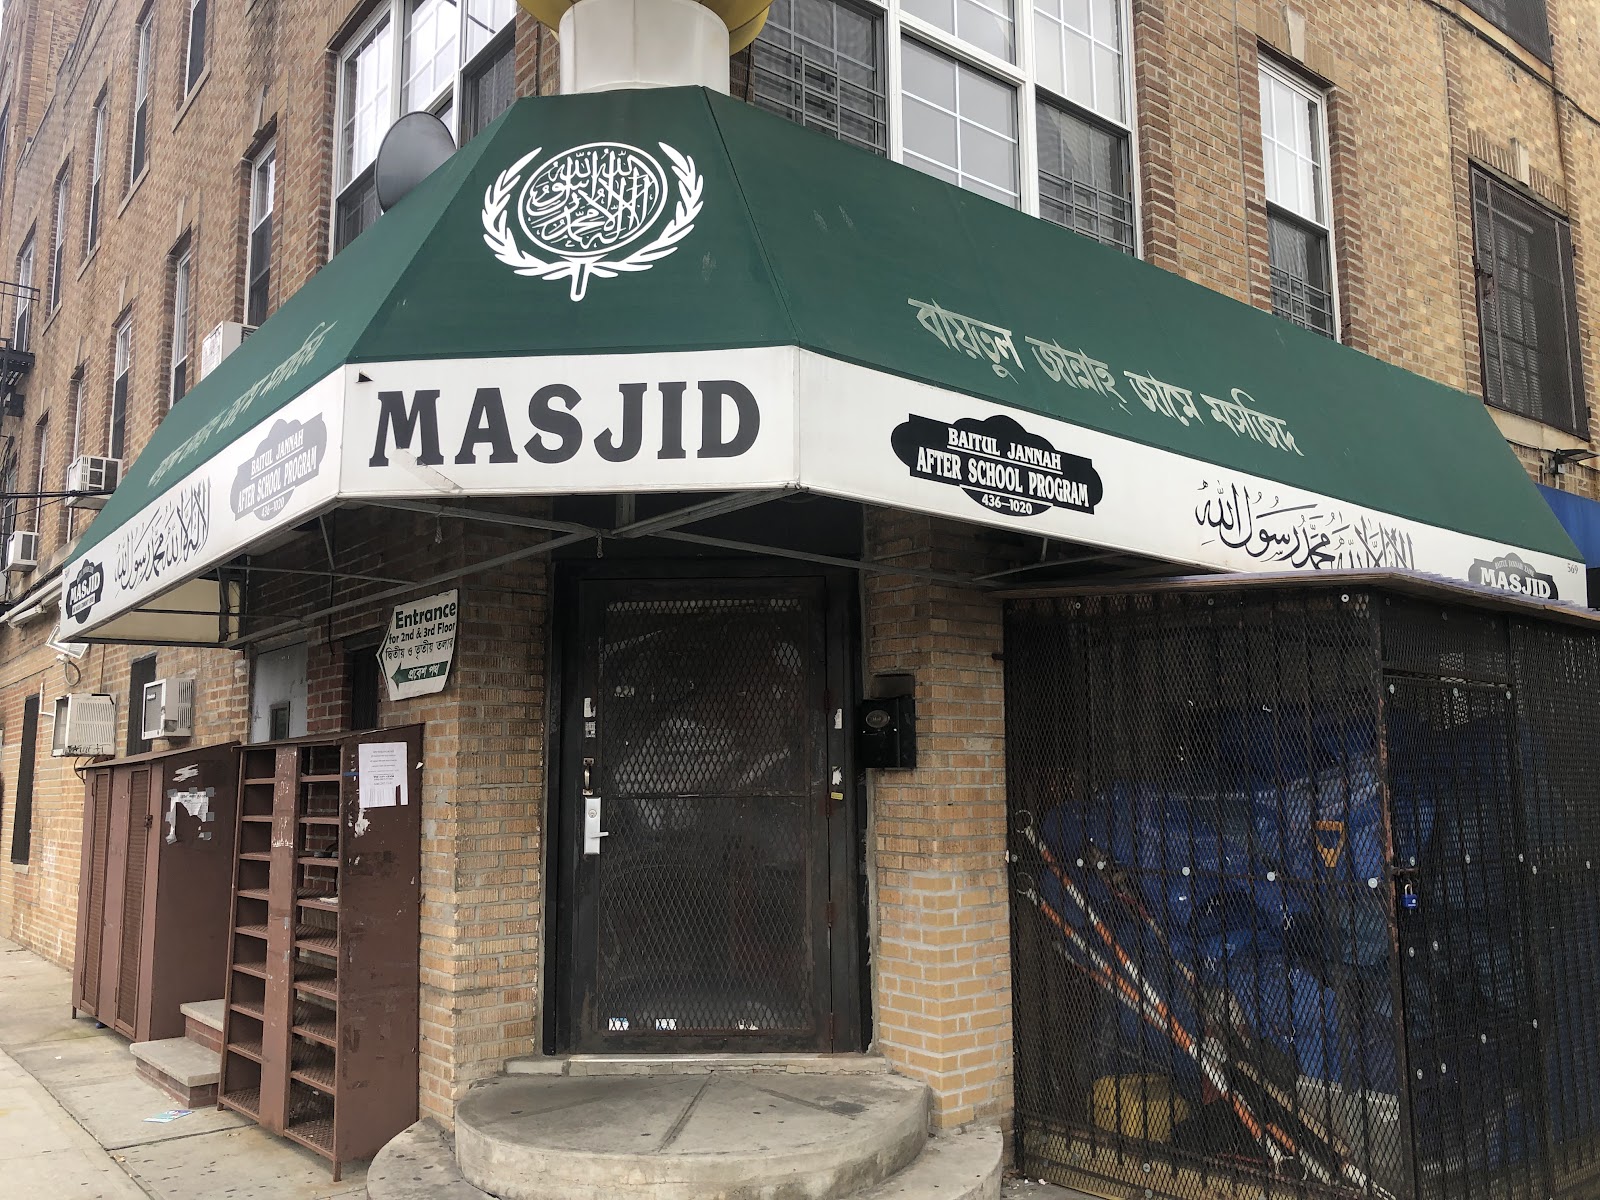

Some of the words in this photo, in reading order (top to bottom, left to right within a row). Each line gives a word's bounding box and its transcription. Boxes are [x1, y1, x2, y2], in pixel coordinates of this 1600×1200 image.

[1124, 370, 1204, 427] জামে
[369, 380, 760, 467] MASJID
[251, 449, 273, 476] BAITUL
[276, 429, 304, 460] JANNAH
[948, 428, 1000, 455] BAITUL
[1007, 443, 1062, 470] JANNAH
[238, 482, 256, 513] AFTER
[257, 467, 281, 502] SCHOOL
[284, 445, 317, 486] PROGRAM
[916, 446, 962, 480] AFTER
[968, 458, 1023, 493] SCHOOL
[1028, 471, 1090, 508] PROGRAM
[70, 571, 101, 606] MASJID
[1480, 567, 1551, 598] MASJID
[389, 633, 399, 644] for
[401, 629, 414, 642] 2nd
[416, 628, 421, 638] &
[424, 624, 435, 637] 3rd
[437, 622, 455, 634] Floor
[396, 602, 456, 629] Entrance
